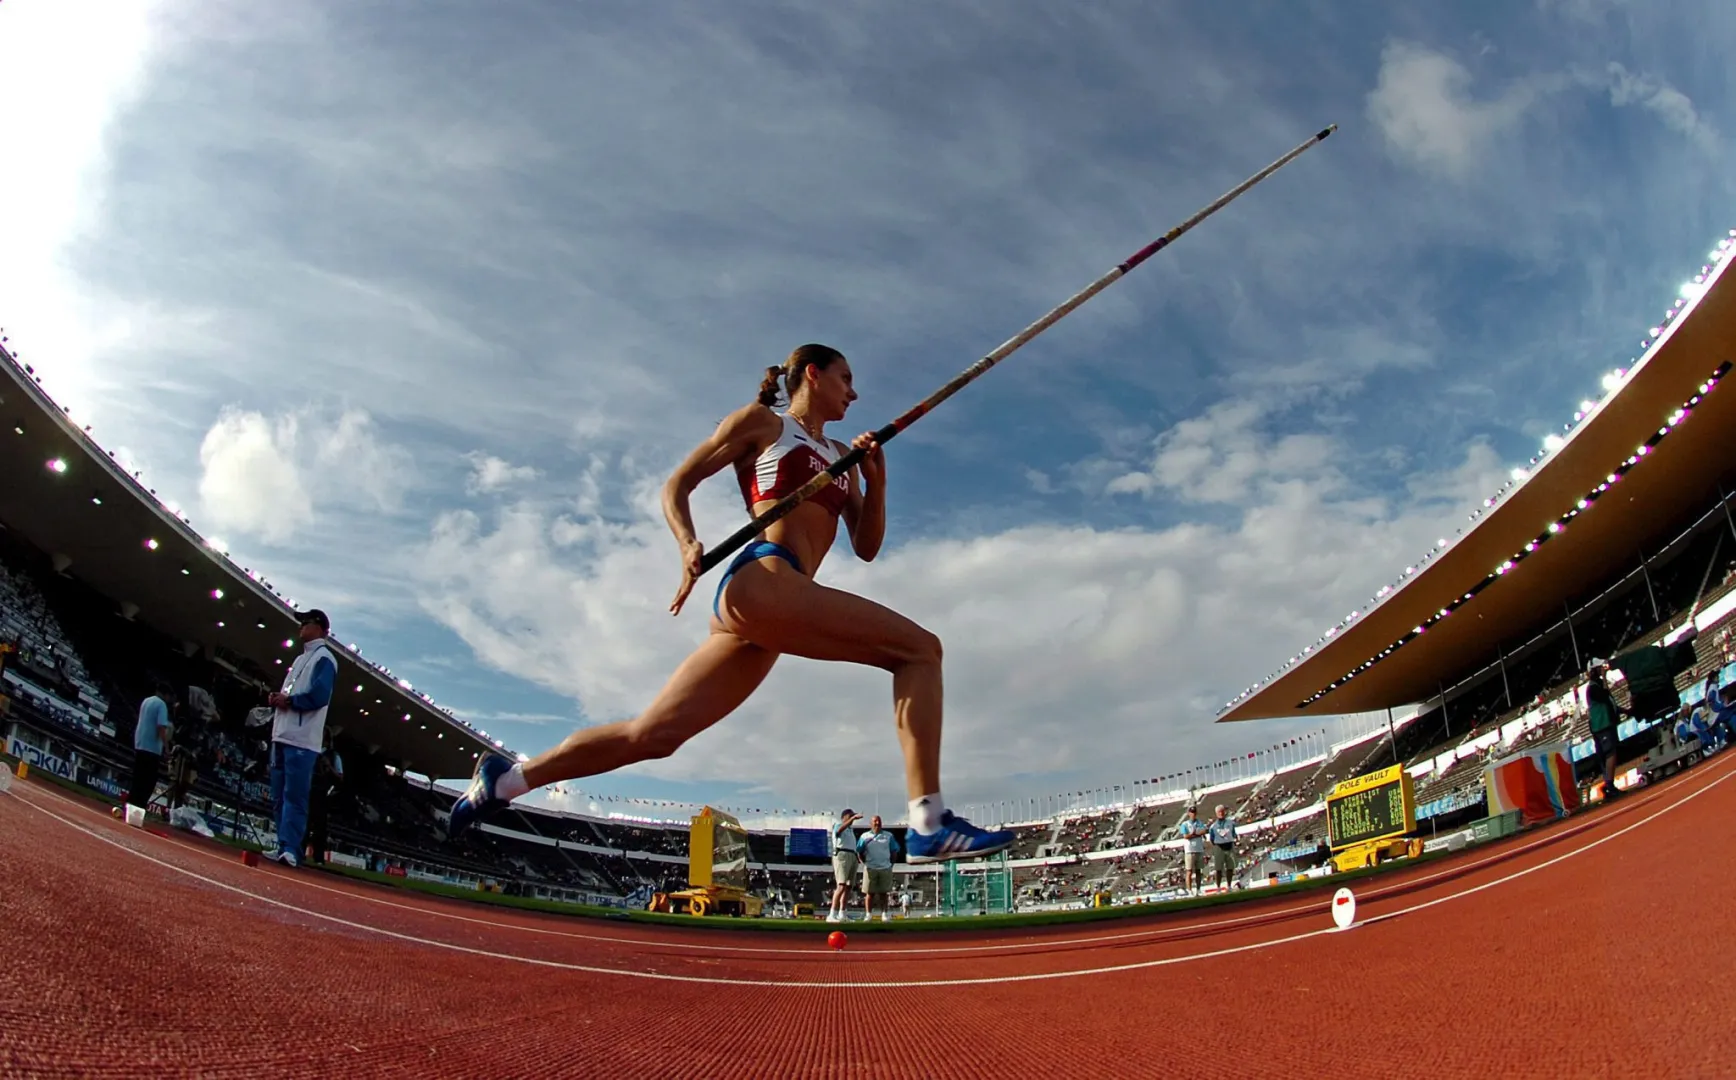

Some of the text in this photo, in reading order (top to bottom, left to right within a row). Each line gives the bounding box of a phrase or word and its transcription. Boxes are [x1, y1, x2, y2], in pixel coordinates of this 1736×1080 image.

[808, 455, 849, 494] RUIA
[12, 739, 70, 777] NOKIA
[86, 774, 109, 791] LAPIN
[1339, 770, 1389, 790] POLE VAULT
